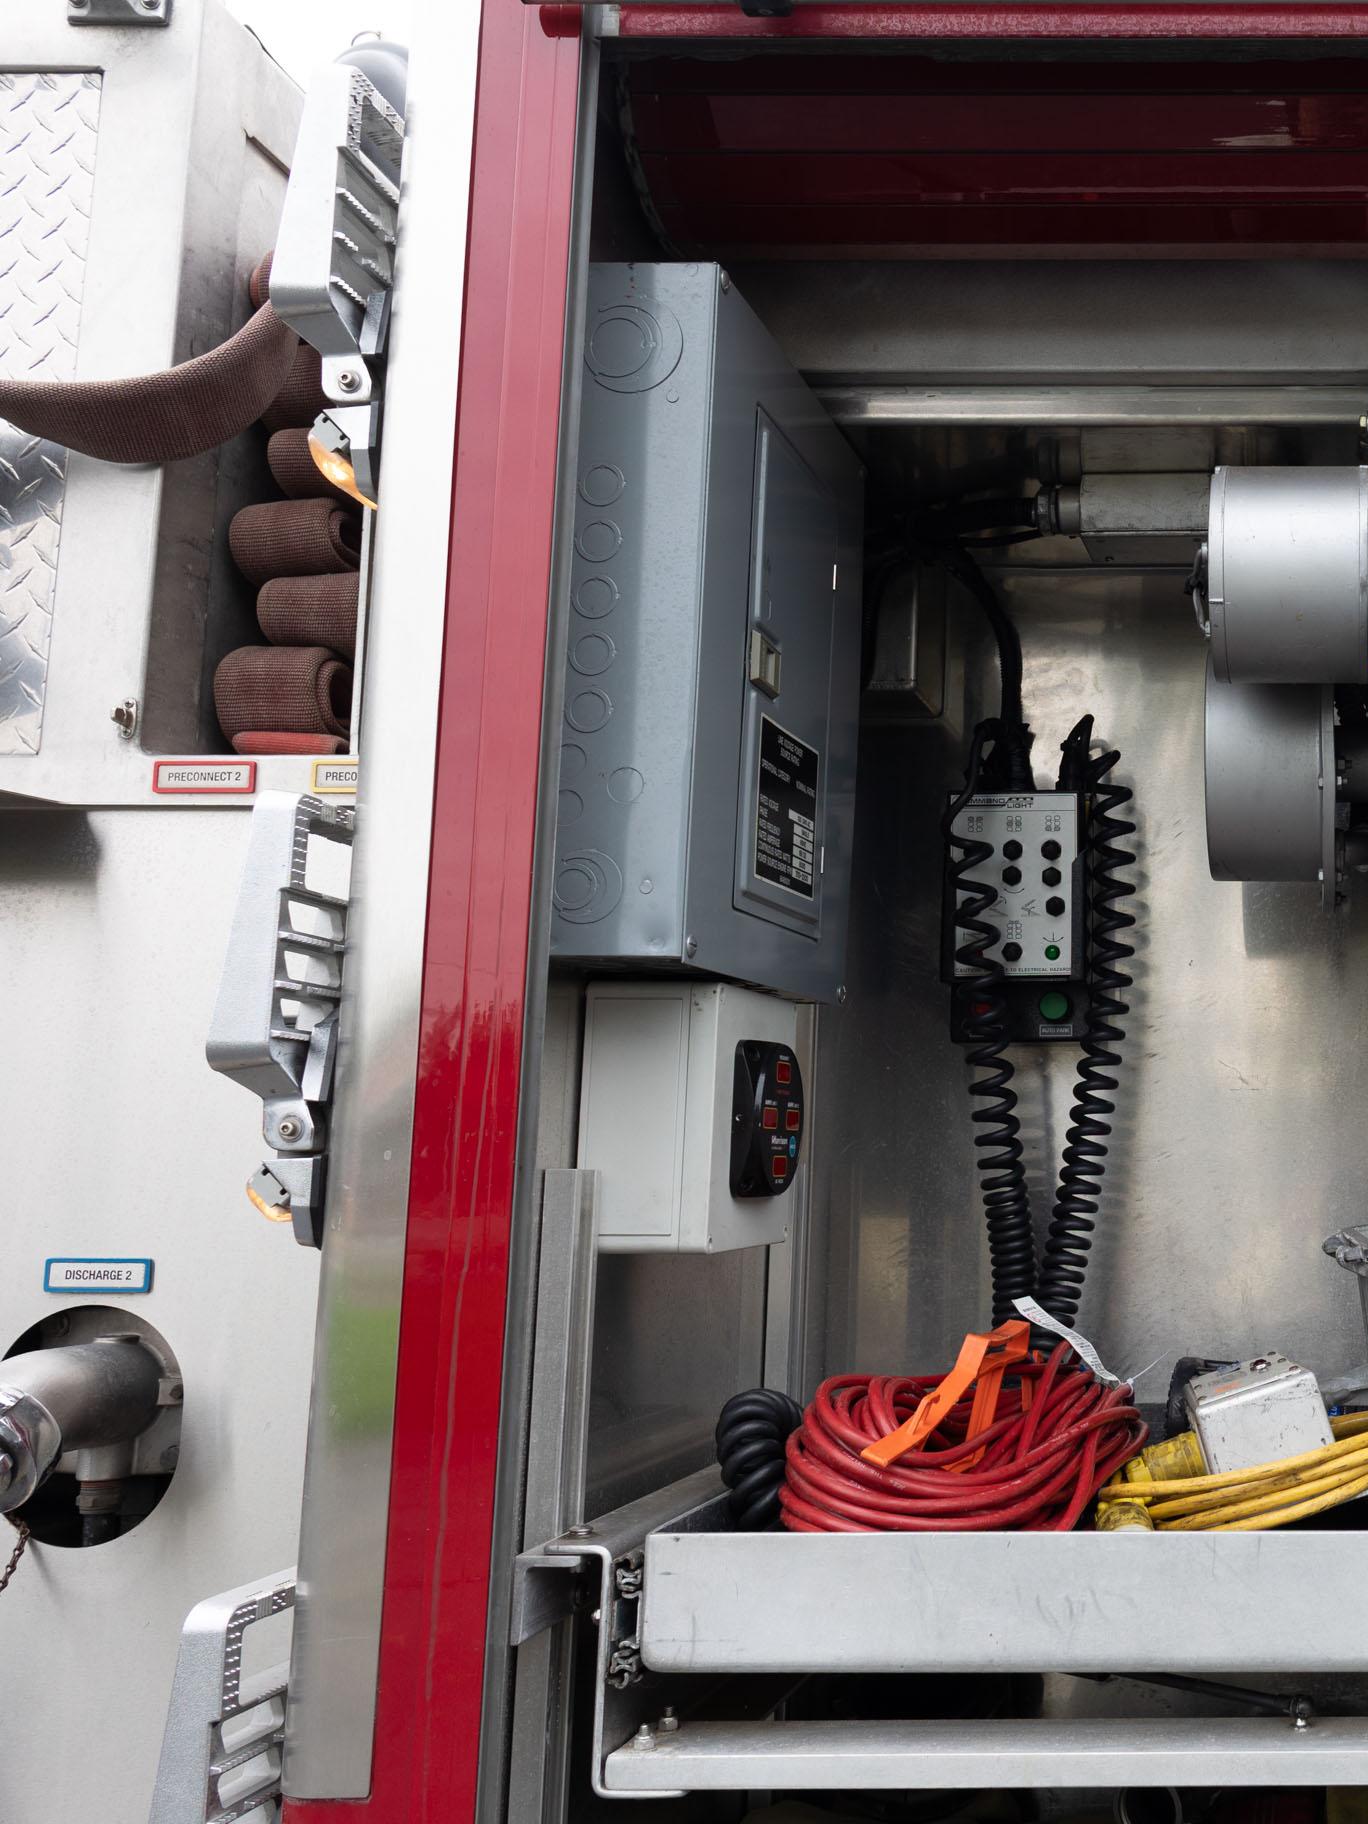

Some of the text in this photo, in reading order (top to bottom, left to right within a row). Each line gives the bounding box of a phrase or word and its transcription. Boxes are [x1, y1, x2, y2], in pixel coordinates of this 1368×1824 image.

[168, 771, 241, 782] PRECONNECT 2
[325, 771, 358, 782] PRECO
[65, 1269, 132, 1281] DISCHARGE 2
